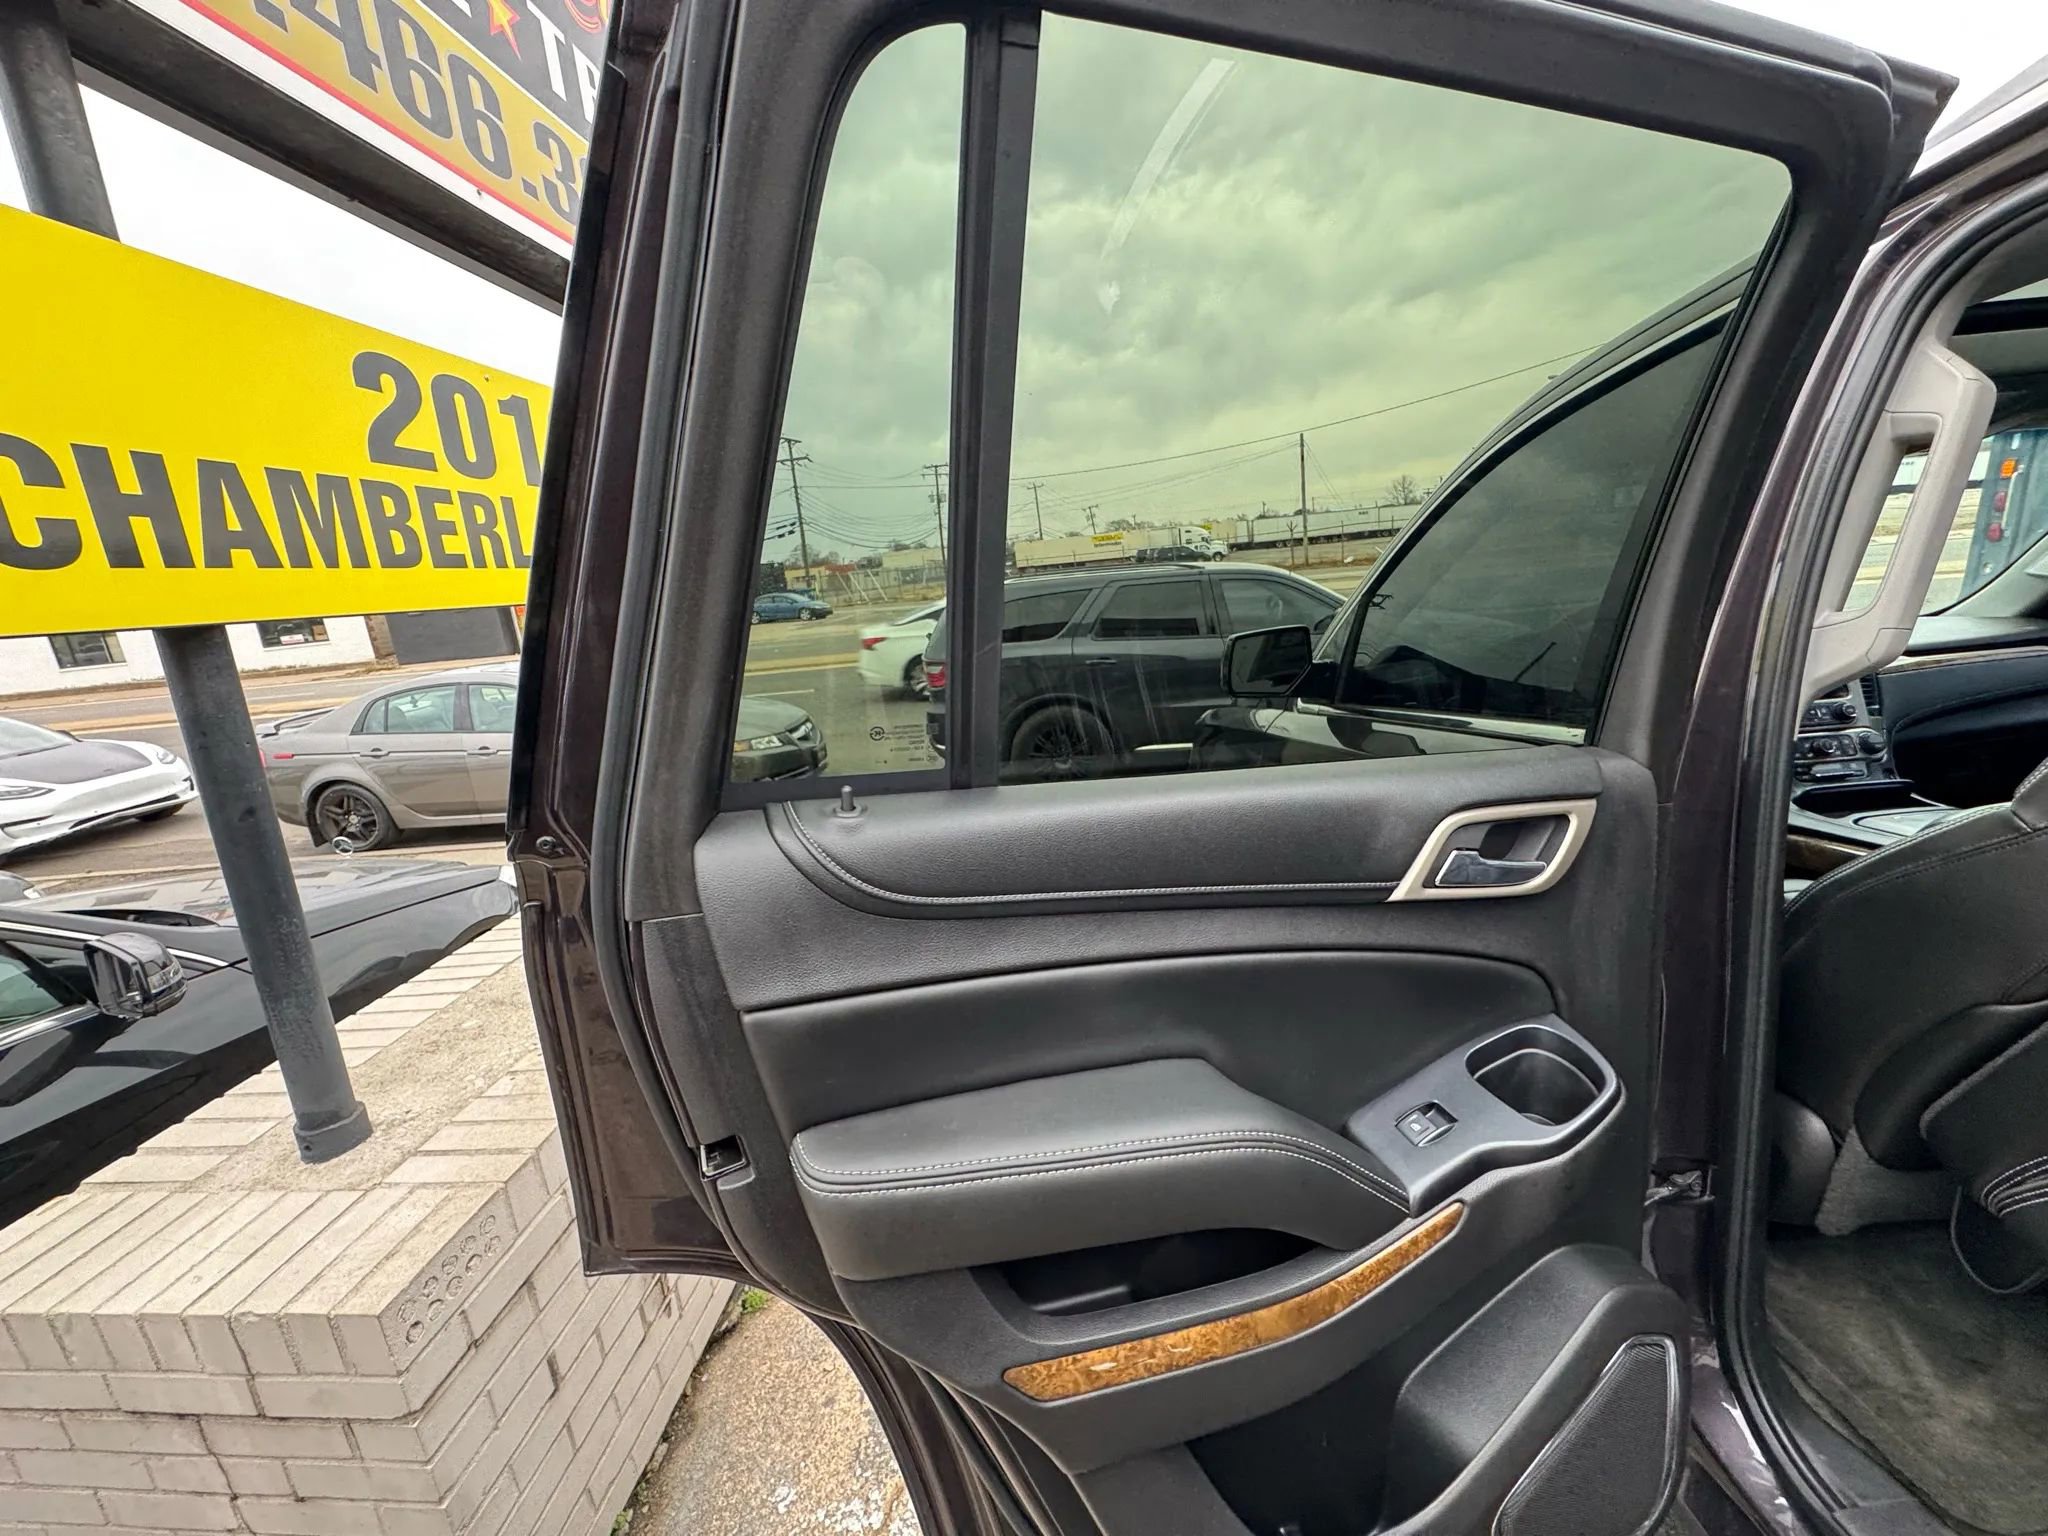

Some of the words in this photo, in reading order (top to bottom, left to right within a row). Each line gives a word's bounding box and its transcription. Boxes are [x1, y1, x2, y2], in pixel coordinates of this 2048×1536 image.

[254, 0, 588, 226] .466.3
[352, 351, 541, 486] 201
[0, 433, 532, 570] CHAMBERL
